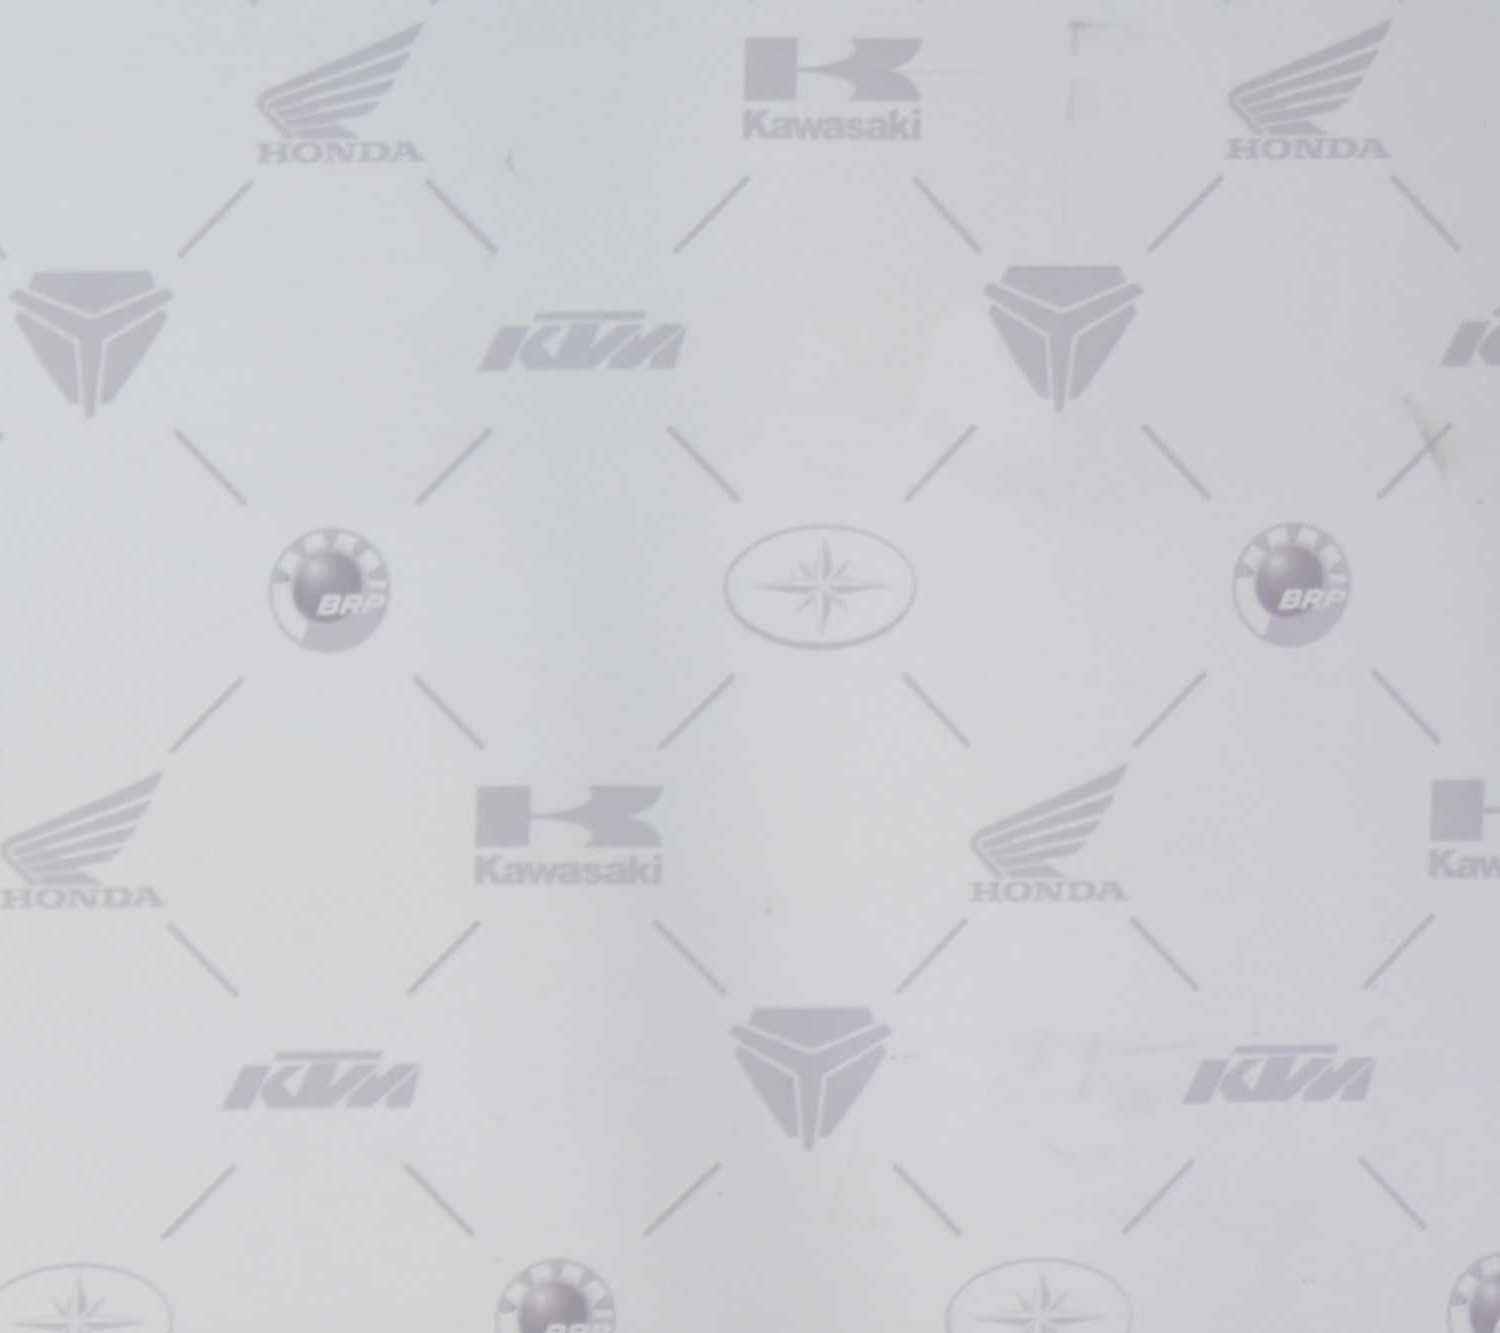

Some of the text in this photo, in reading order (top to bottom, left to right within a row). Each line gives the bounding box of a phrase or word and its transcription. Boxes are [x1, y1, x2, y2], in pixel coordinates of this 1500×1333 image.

[743, 108, 922, 140] Kawasaki
[259, 141, 424, 163] HONDA
[1228, 137, 1391, 160] HONDA
[480, 311, 685, 371] KTM
[316, 594, 386, 617] BRP
[1278, 588, 1346, 611] BRP
[475, 854, 663, 885] Kawasaki
[2, 887, 164, 909] HONDA
[972, 880, 1128, 903] HONDA
[223, 1051, 420, 1110] KTM
[1183, 1045, 1374, 1104] KTM
